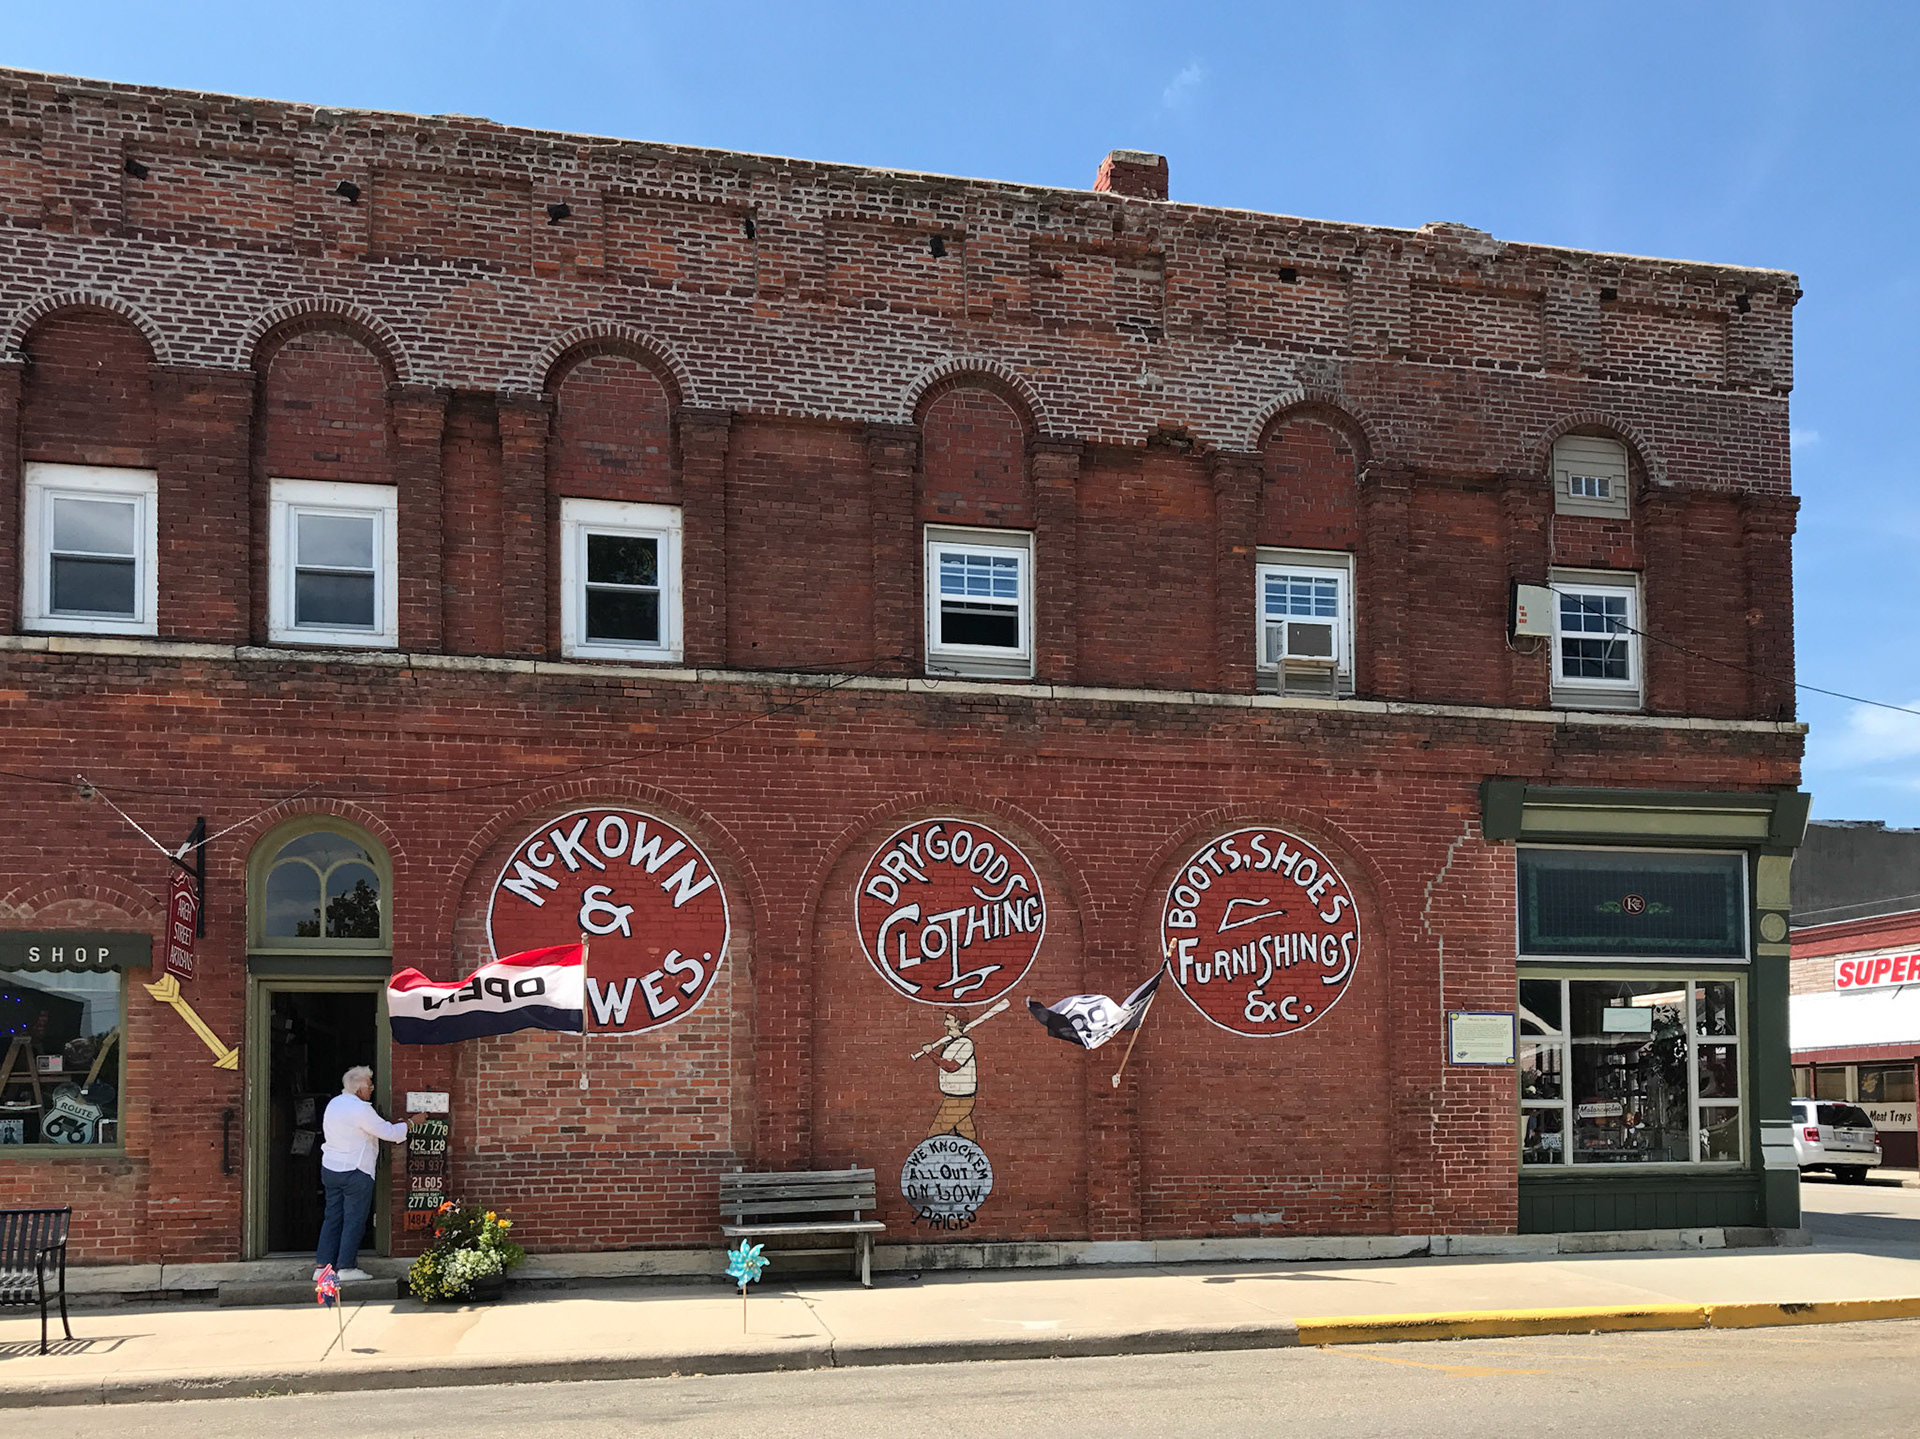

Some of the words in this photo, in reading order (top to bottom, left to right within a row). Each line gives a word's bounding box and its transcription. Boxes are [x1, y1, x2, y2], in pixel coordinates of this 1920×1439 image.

[865, 832, 930, 906] DRY
[923, 823, 1030, 901] GOODS
[1250, 832, 1351, 924] SHOES
[177, 898, 192, 923] ARCH
[577, 884, 635, 938] &
[173, 921, 193, 947] STREET
[28, 946, 110, 963] SHOP
[168, 944, 194, 971] ARTISANS
[876, 896, 1044, 999] CLOTHING
[1178, 930, 1355, 988] FURNISHINGS
[1836, 953, 1920, 989] SUPER
[60, 1101, 95, 1119] ROUTE
[1869, 1109, 1888, 1122] Meat
[1889, 1109, 1913, 1126] Trays
[46, 1114, 88, 1144] 66
[431, 1123, 449, 1136] 778
[409, 1138, 427, 1151] 452
[430, 1139, 446, 1151] 128
[907, 1148, 928, 1167] WE
[411, 1176, 423, 1189] 21
[424, 1176, 443, 1189] 605
[909, 1167, 939, 1180] ALL
[940, 1163, 968, 1180] OUT
[408, 1196, 425, 1208] 277
[427, 1196, 445, 1208] 697
[907, 1183, 929, 1200] ON
[935, 1183, 982, 1203] LOW
[911, 1204, 977, 1231] PRICES
